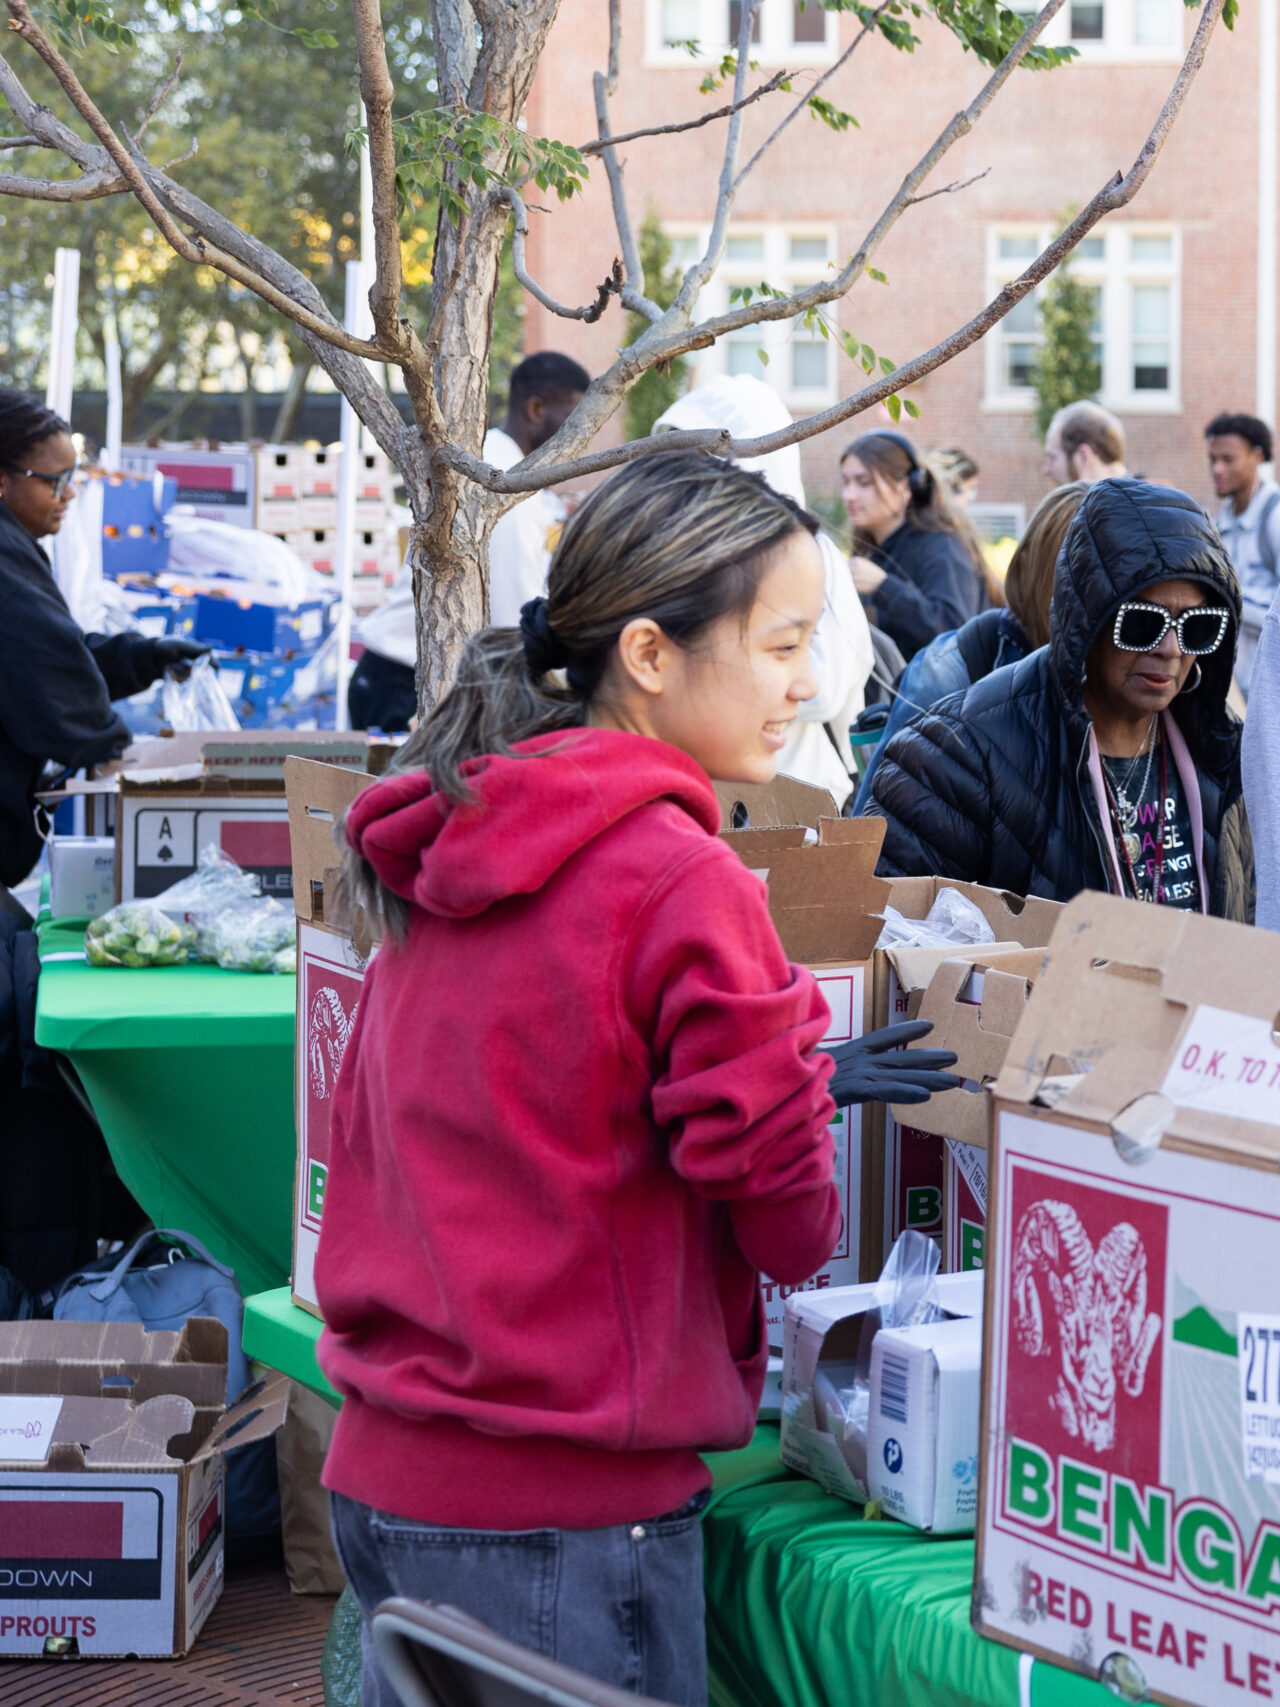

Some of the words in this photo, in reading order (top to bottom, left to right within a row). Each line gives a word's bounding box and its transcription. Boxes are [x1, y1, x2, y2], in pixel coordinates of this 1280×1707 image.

[203, 756, 244, 766] KEEP
[1181, 1044, 1226, 1080] O.K.
[1236, 1057, 1267, 1084] TO
[1025, 1569, 1093, 1629] RED
[1106, 1601, 1206, 1670] LEAF
